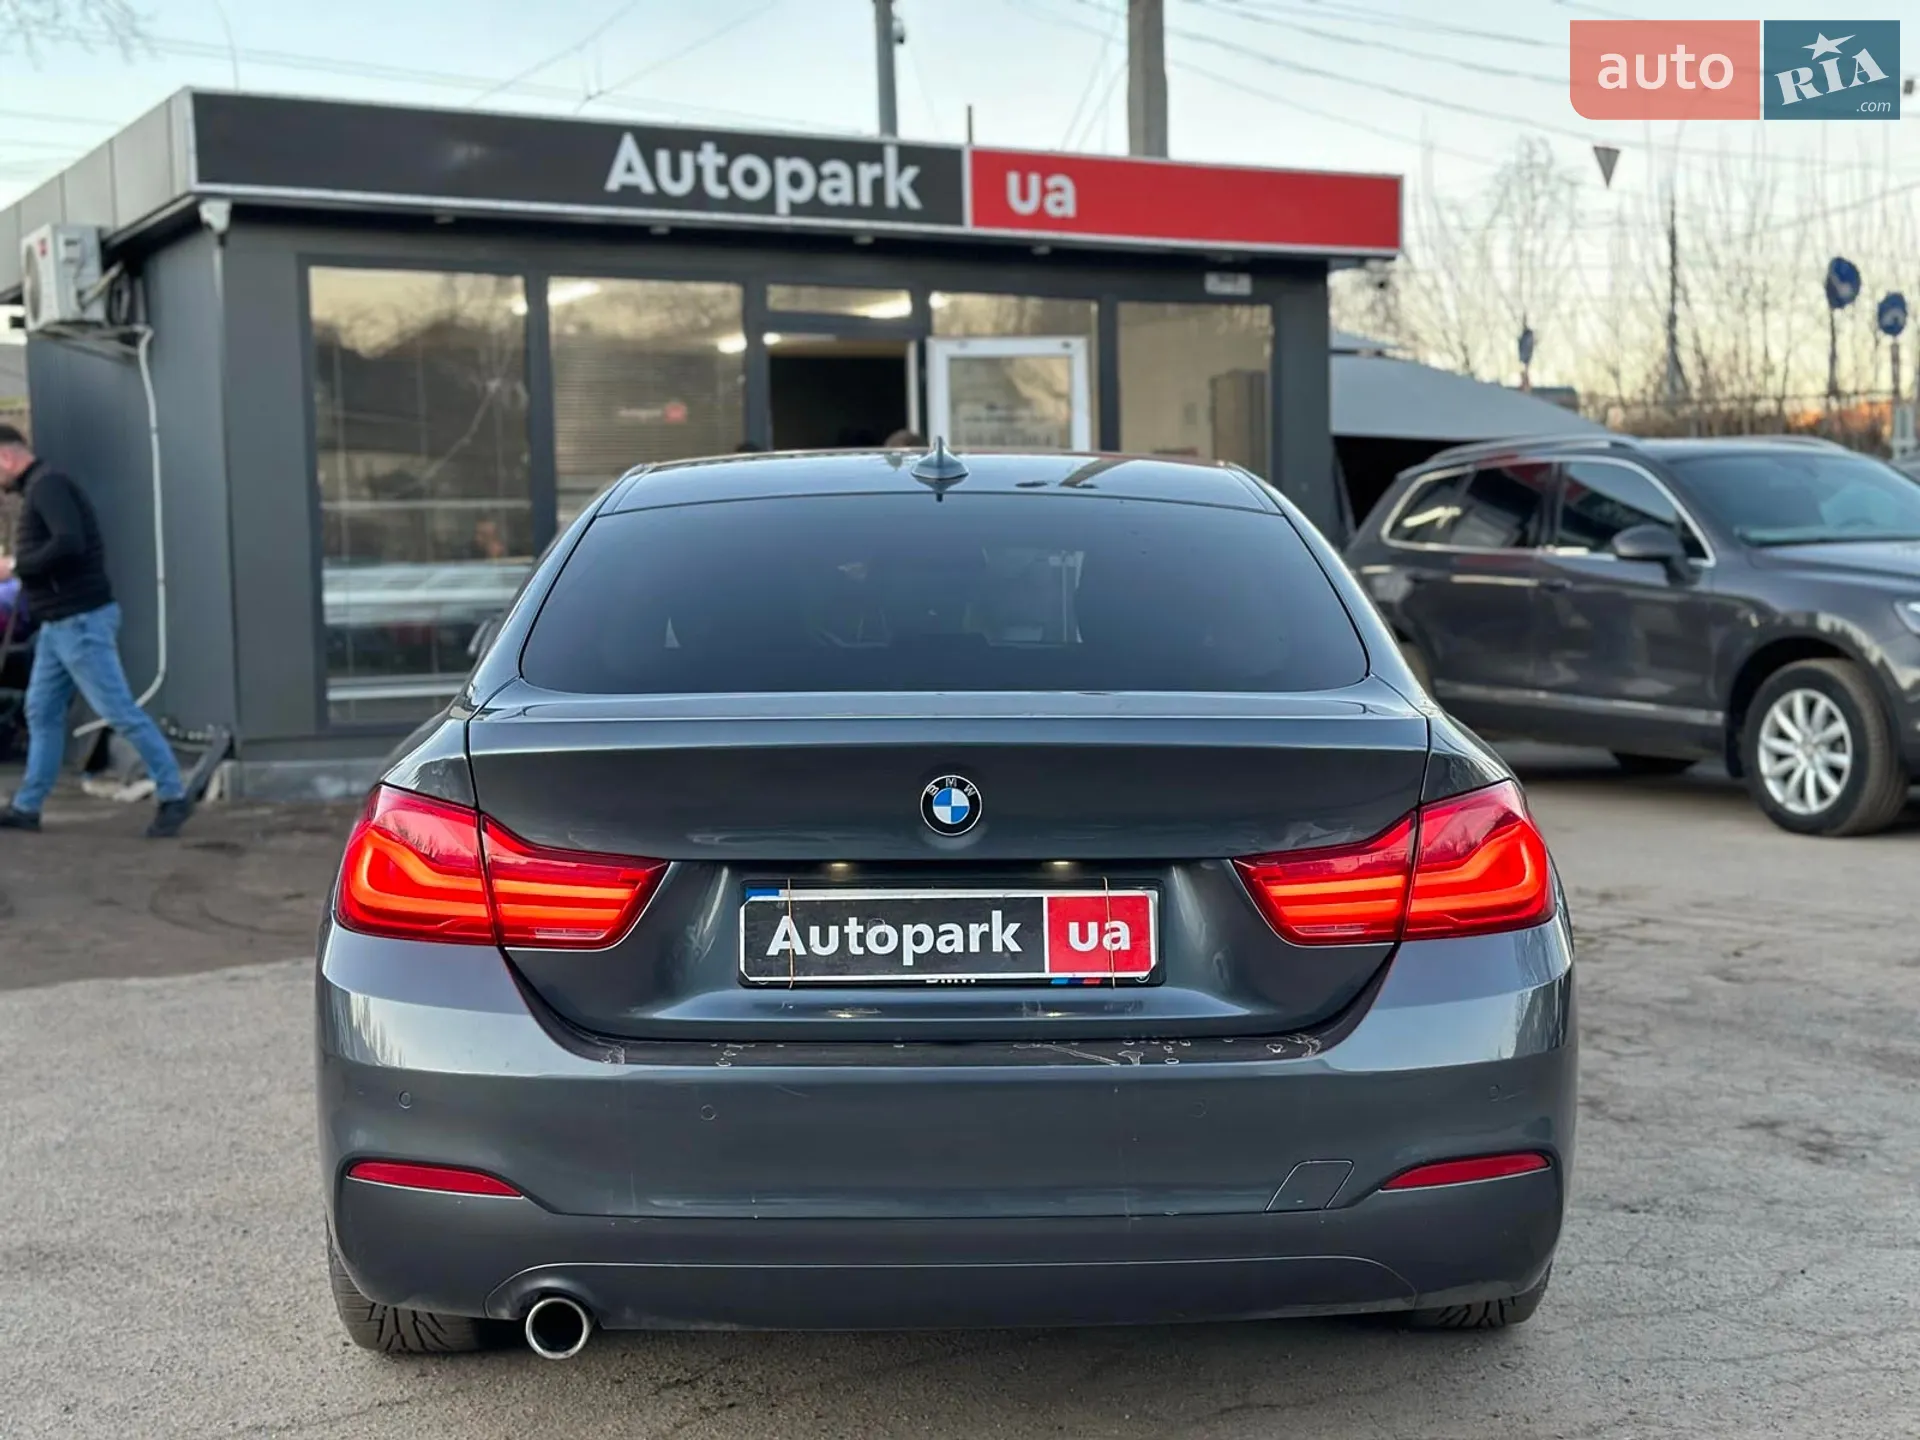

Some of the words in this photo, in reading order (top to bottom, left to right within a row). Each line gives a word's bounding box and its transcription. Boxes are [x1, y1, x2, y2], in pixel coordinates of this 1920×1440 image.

[604, 131, 922, 215] Autopark
[1006, 170, 1076, 218] ua
[926, 777, 977, 797] BMW
[766, 910, 1023, 966] Autopark
[1067, 919, 1131, 952] ua
